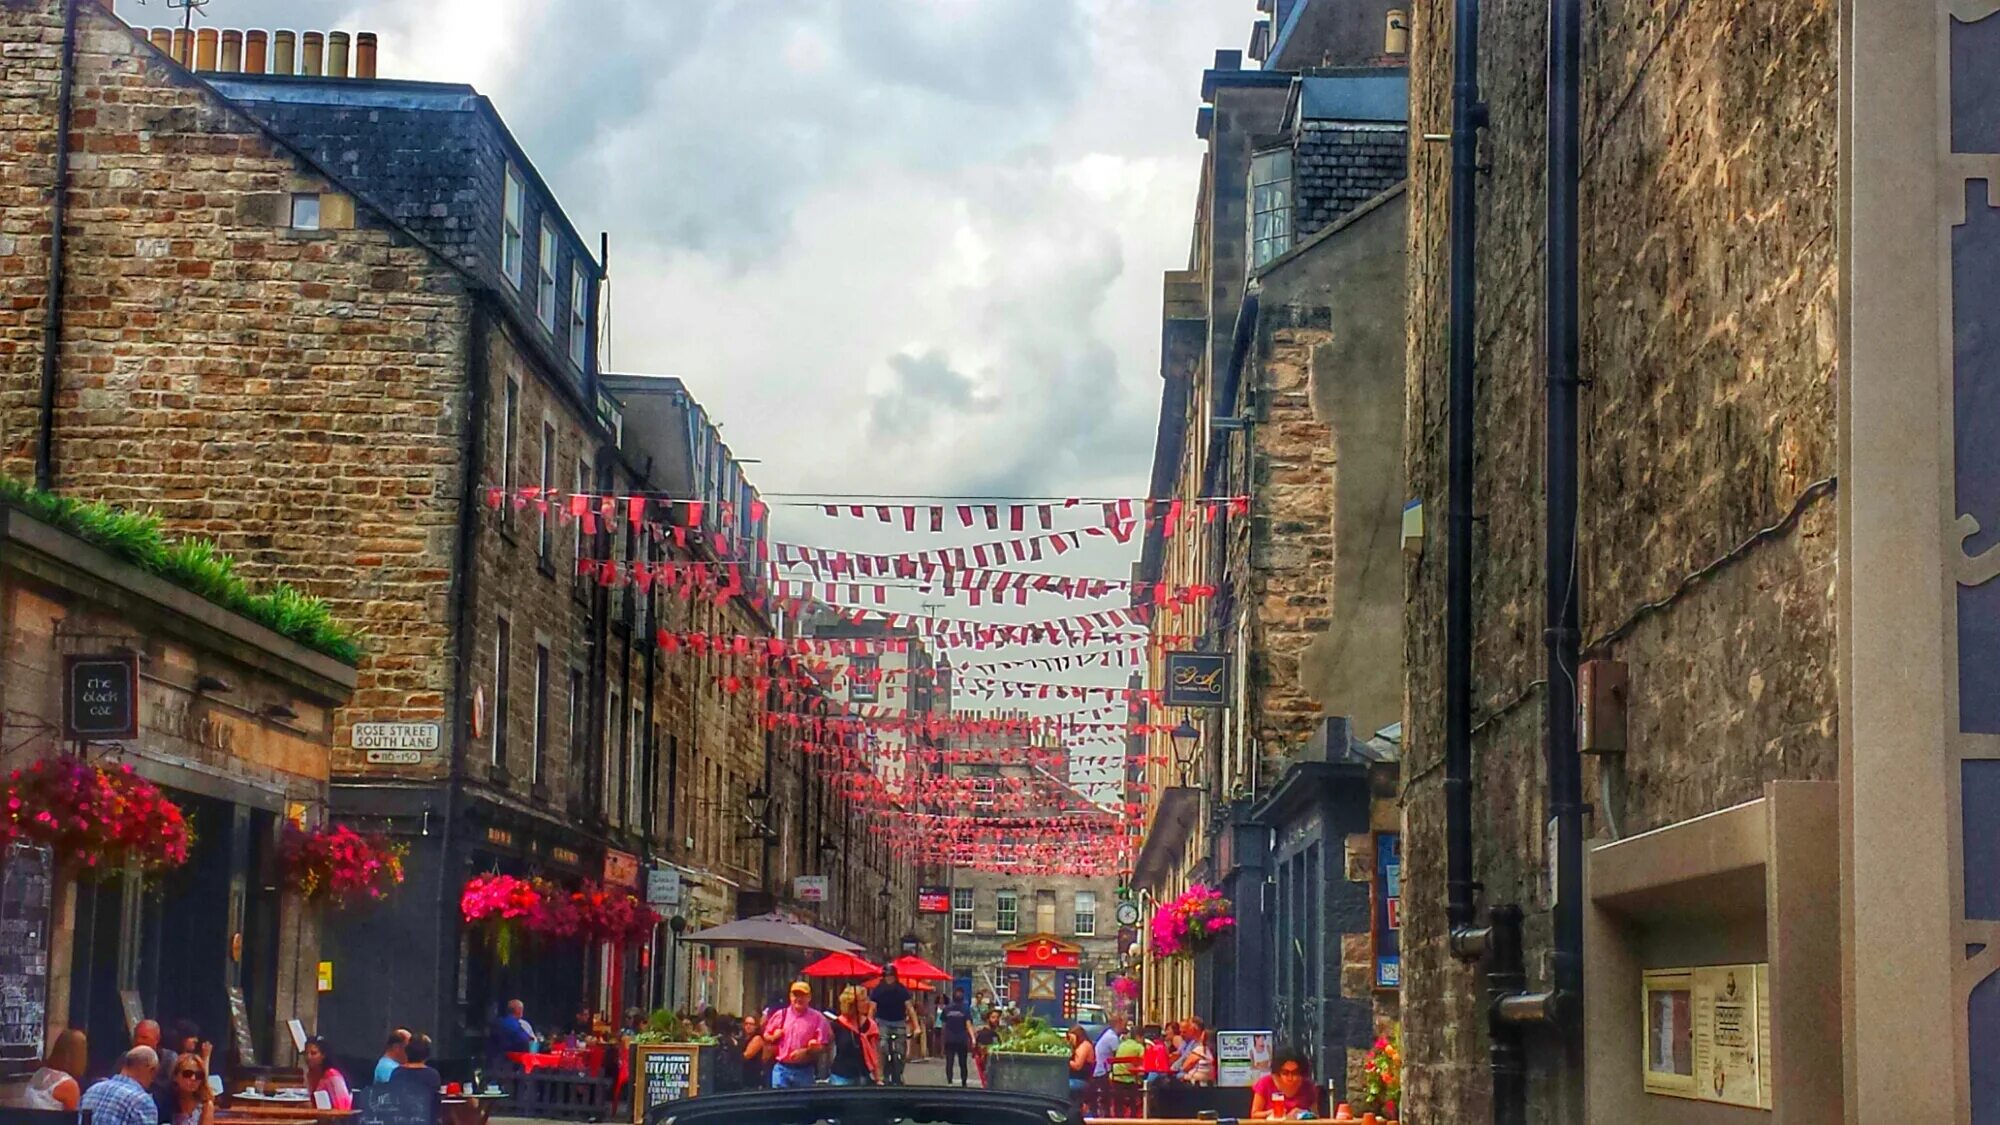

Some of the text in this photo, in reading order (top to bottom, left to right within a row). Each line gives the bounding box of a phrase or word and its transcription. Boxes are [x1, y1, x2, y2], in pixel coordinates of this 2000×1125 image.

[82, 691, 118, 702] black
[355, 725, 435, 737] ROSE STREET
[357, 737, 433, 747] SOUTH LANE
[1222, 1036, 1249, 1046] LOSE
